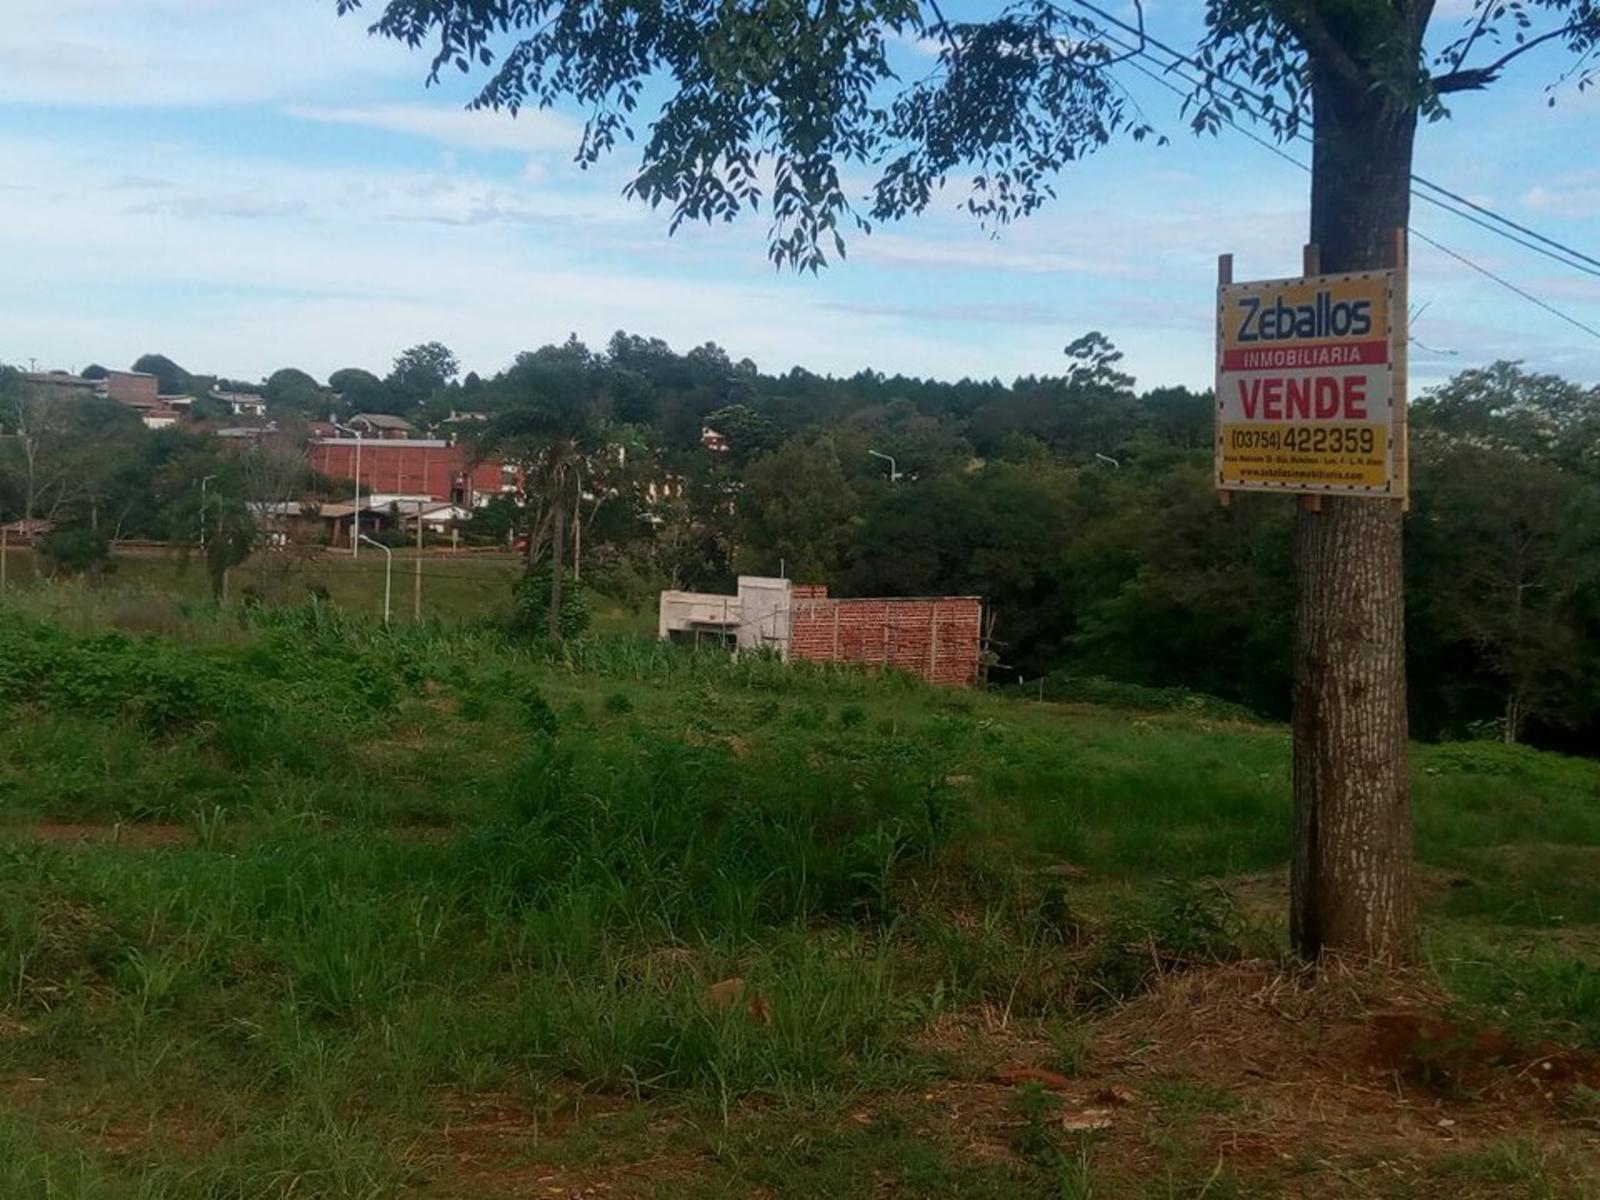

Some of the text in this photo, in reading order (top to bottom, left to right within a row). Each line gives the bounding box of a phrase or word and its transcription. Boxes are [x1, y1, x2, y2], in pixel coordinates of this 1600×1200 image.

[1238, 292, 1371, 342] Zeballos
[1243, 347, 1361, 368] INMOBILIARIA
[1238, 375, 1367, 420] VENDE
[1231, 427, 1374, 454] (03754) 422359
